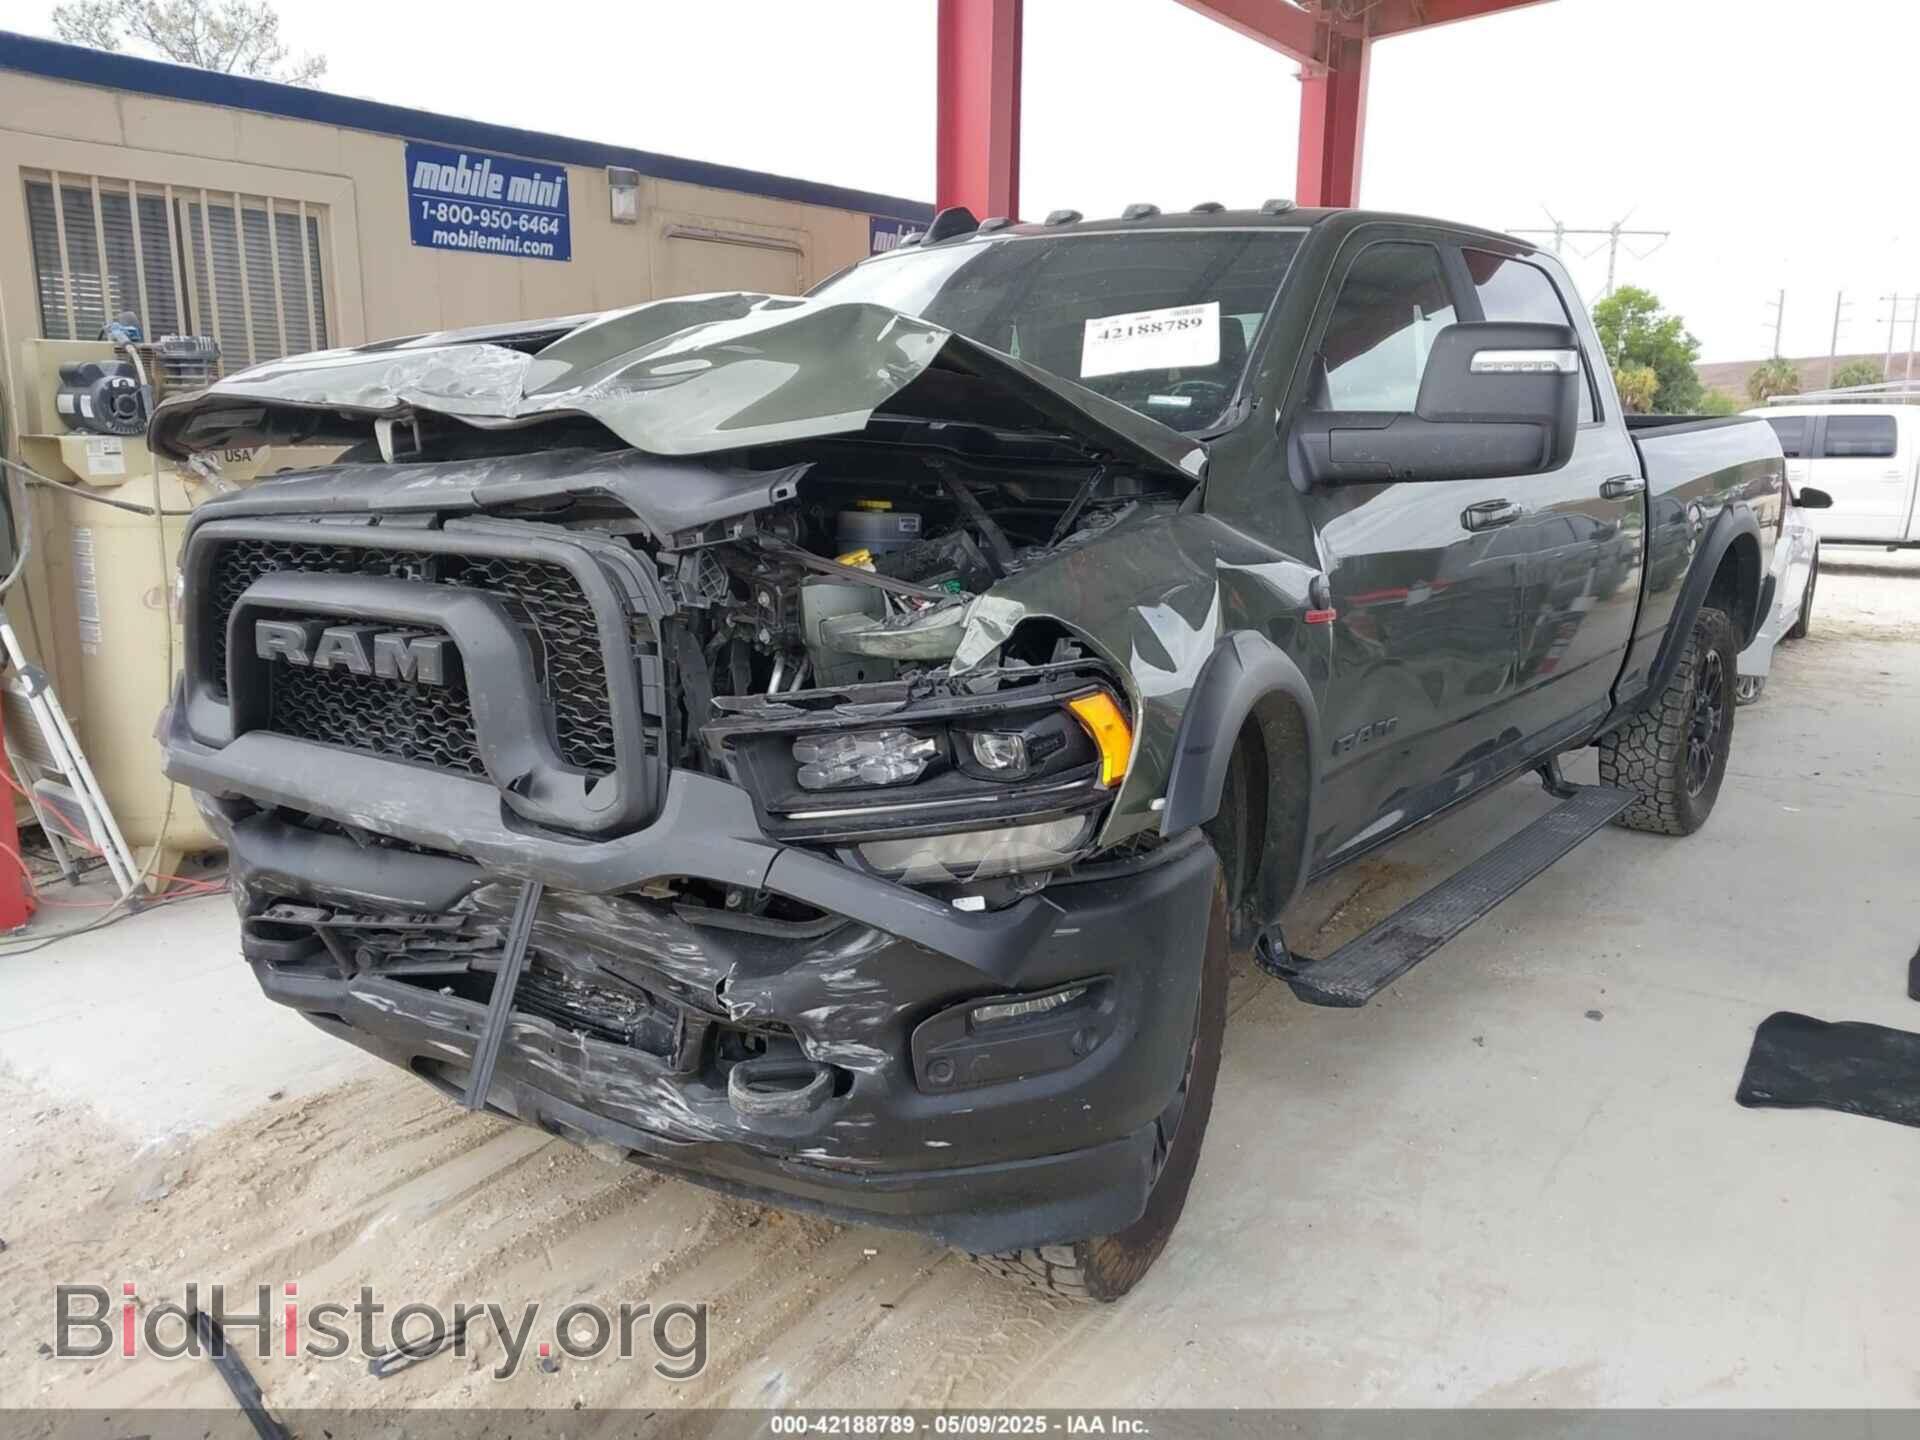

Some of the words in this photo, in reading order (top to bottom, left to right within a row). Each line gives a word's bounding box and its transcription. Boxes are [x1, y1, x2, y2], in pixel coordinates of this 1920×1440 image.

[412, 154, 504, 200] mobile
[507, 172, 562, 208] mini
[421, 201, 560, 235] 1-800-950-6464
[432, 230, 554, 257] mobilemini.com
[1097, 317, 1203, 340] 42188789
[225, 448, 252, 462] USA
[255, 618, 446, 686] RAM
